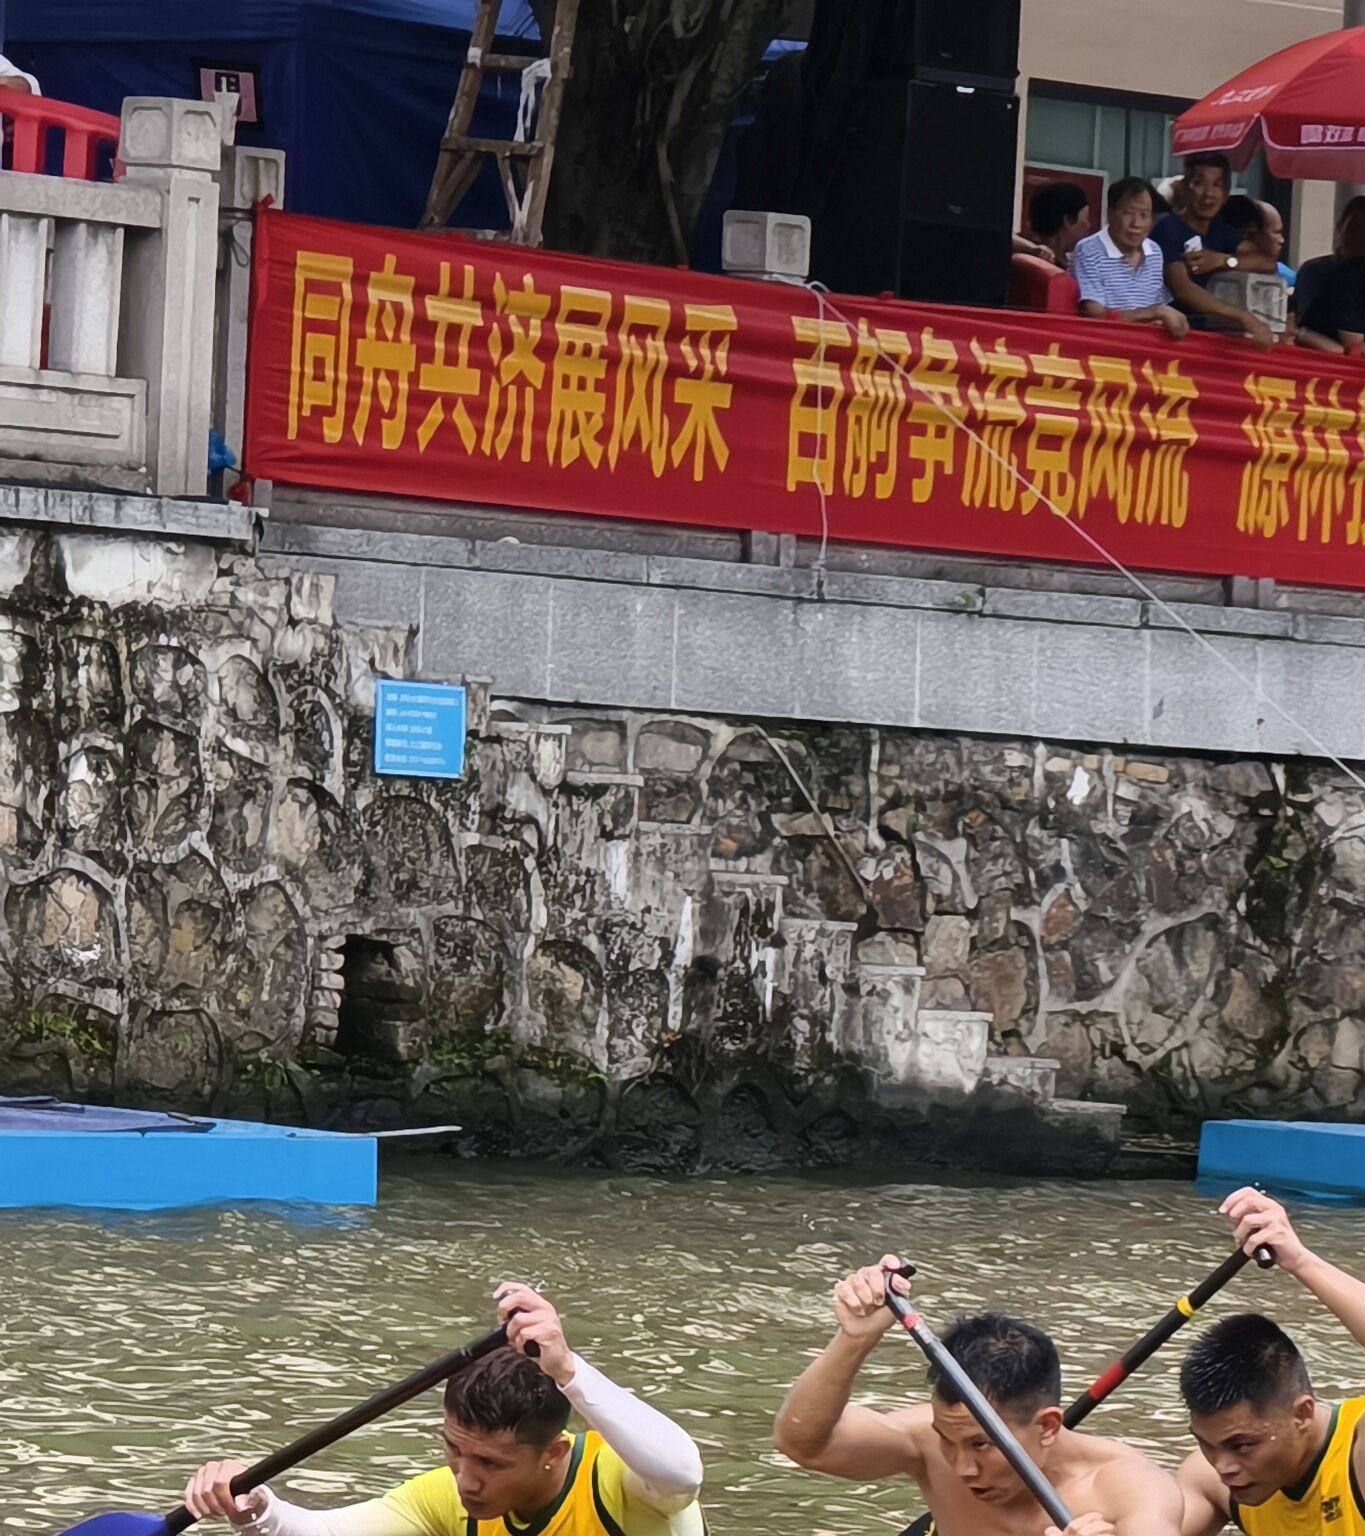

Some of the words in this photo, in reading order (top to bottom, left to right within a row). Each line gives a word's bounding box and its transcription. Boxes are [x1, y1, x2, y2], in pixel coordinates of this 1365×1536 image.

[287, 250, 738, 482] 同舟共济展风采
